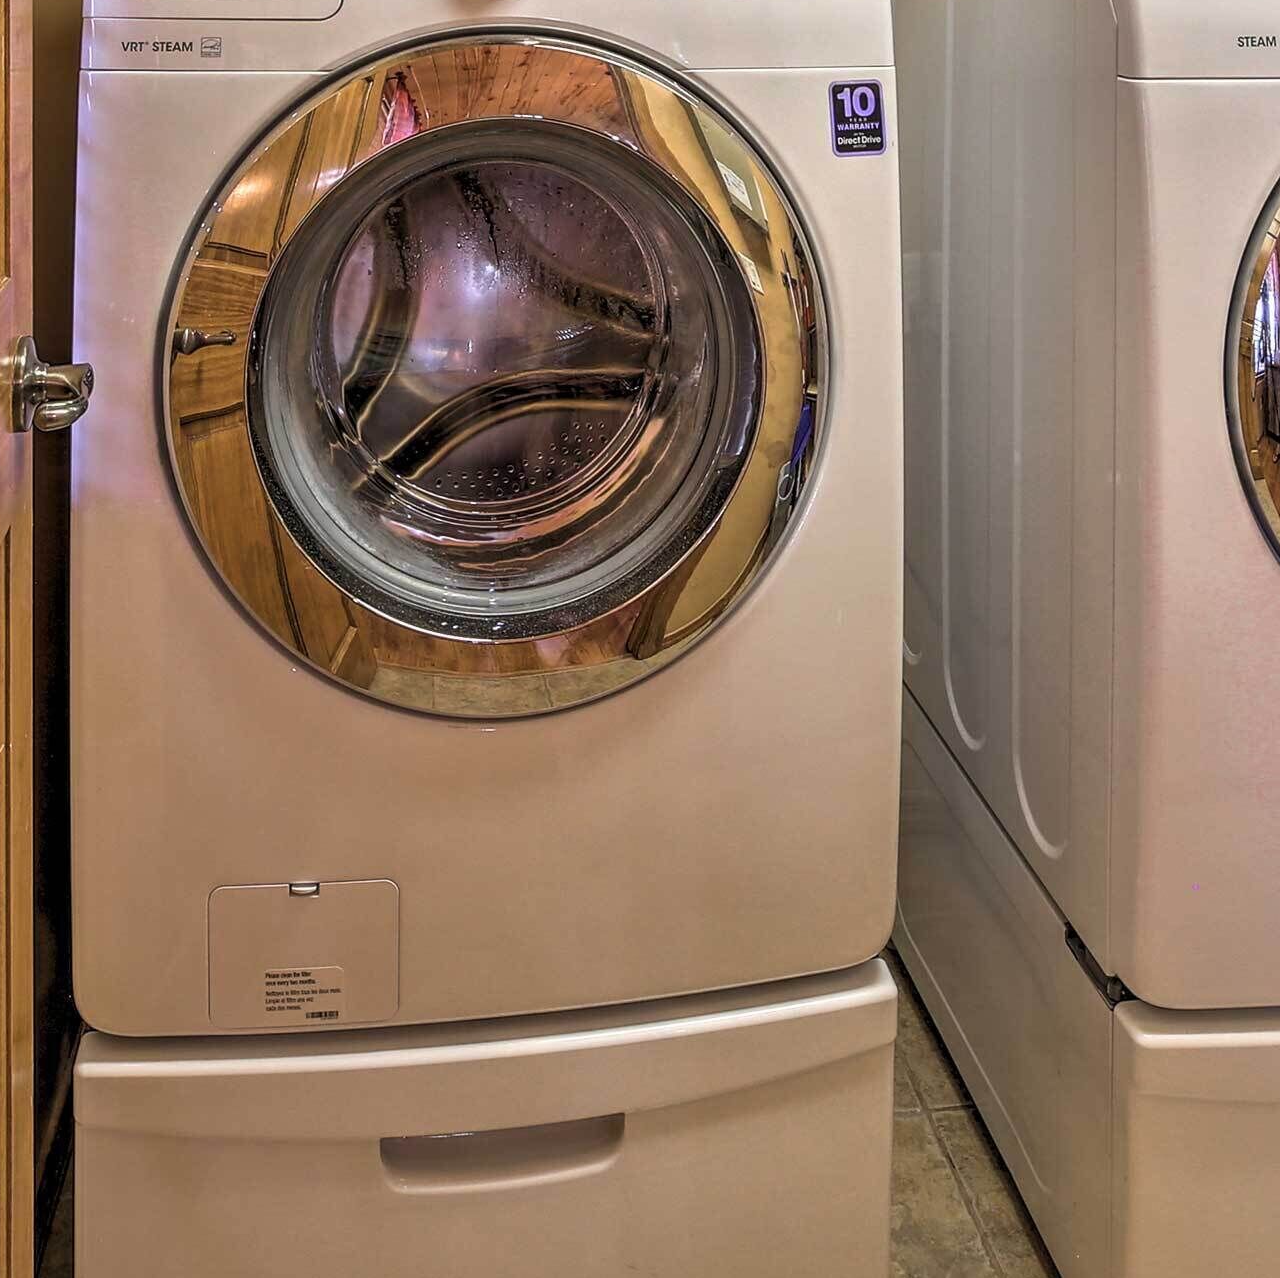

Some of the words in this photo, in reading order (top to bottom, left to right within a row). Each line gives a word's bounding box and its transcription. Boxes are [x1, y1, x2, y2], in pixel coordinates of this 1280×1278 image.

[152, 41, 193, 52] STEAM
[1237, 36, 1277, 47] STEAM
[836, 86, 876, 117] 10
[837, 122, 880, 131] WARRANTY
[837, 135, 860, 145] Direct
[861, 134, 882, 144] Drive
